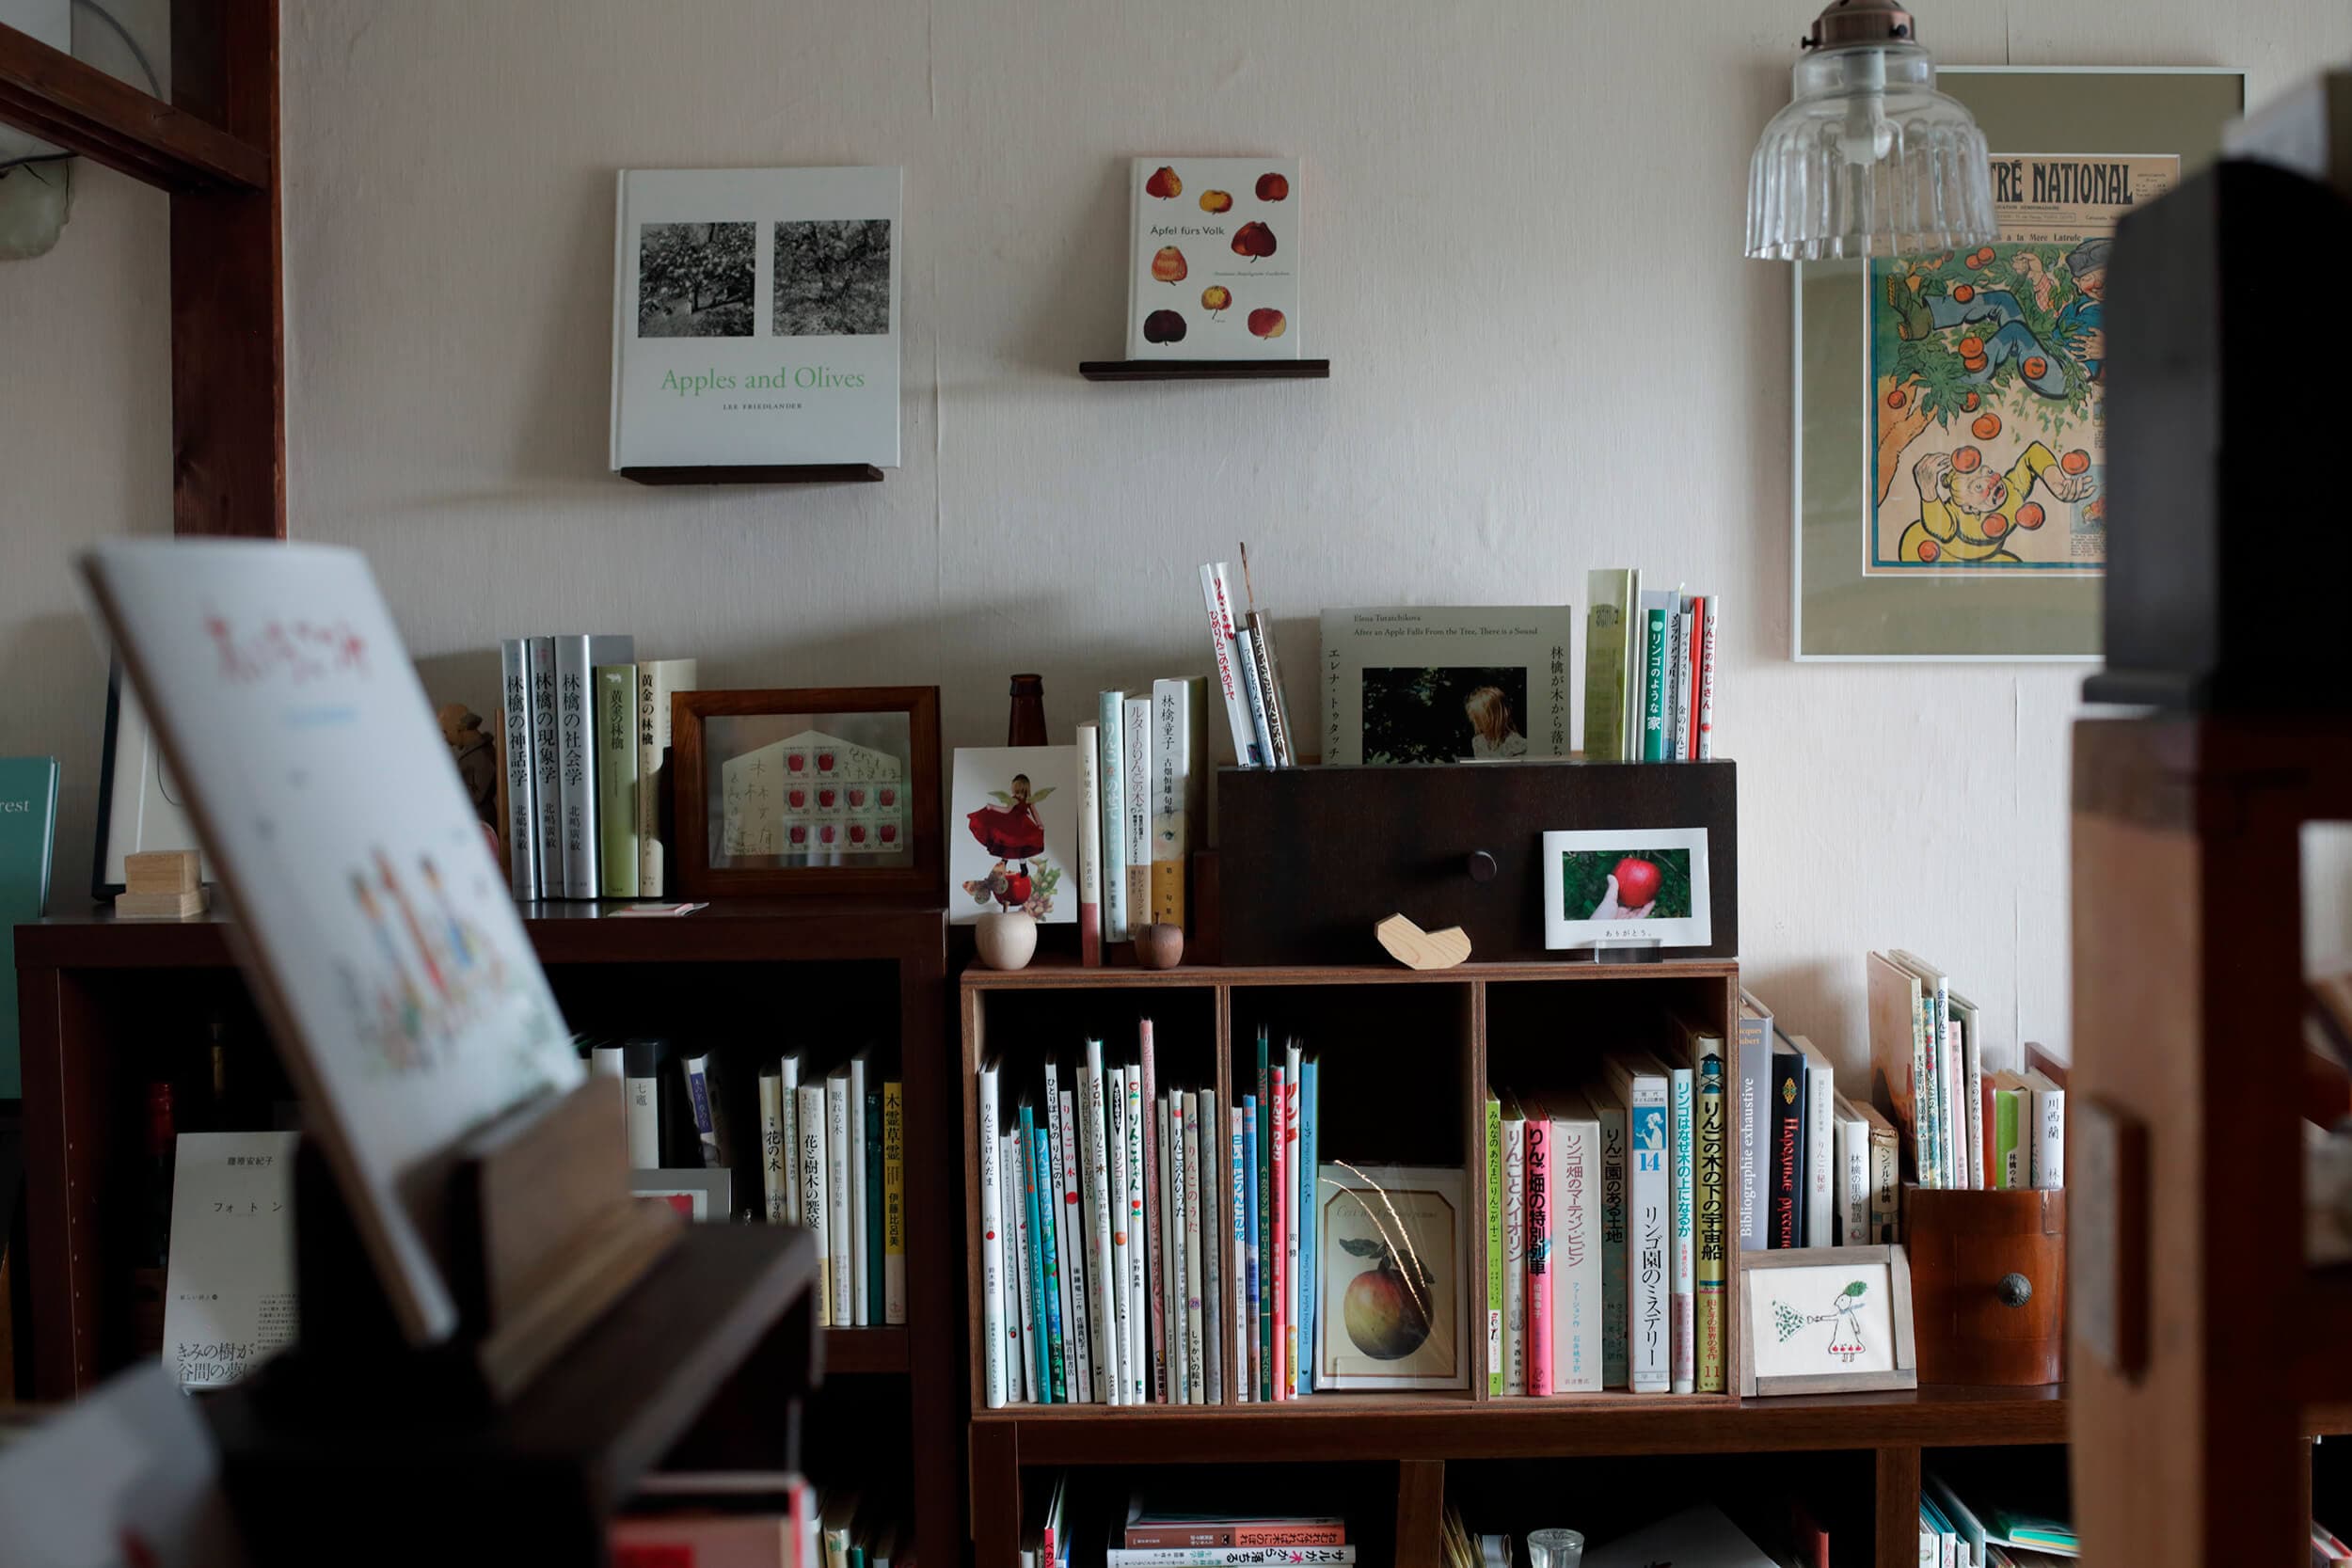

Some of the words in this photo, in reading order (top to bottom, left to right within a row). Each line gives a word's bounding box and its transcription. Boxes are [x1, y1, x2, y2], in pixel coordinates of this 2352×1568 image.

[2032, 162, 2134, 204] NATIONAL
[1151, 225, 1177, 237] Äpfel
[1181, 226, 1200, 235] fürs
[1202, 226, 1225, 235] Volk
[661, 369, 736, 396] Apples
[744, 367, 787, 390] and
[794, 366, 866, 389] Olives
[1209, 610, 1235, 700] ひめりんごの木の下で
[1354, 626, 1373, 636] After
[1384, 627, 1405, 638] Apple
[1406, 626, 1424, 636] Falls
[1424, 626, 1444, 636] From
[1446, 626, 1458, 636] the
[1514, 626, 1538, 635] Sound
[1702, 615, 1715, 710] りんごのおじさん
[642, 673, 654, 746] 黄金の林檎
[1647, 633, 1663, 731] リンゴのような家
[507, 674, 528, 788] 林檎の神話学
[535, 672, 557, 784] 林檎の現象学
[564, 673, 582, 786] 林檎の社会学
[610, 689, 625, 751] 黄金の林檎
[1161, 694, 1175, 751] 林檎童子
[1676, 705, 1687, 756] 金のりんご
[1130, 705, 1144, 807] ルターのりんごの木
[831, 1091, 843, 1134] 眠れる木
[1047, 1078, 1059, 1140] ひとりぼっちの
[1489, 1110, 1499, 1148] みんなの
[1740, 1077, 1755, 1148] exhaustive
[2047, 1098, 2060, 1140] 川西蘭
[766, 1130, 782, 1172] 花の木
[984, 1102, 994, 1187] りんごとけんだま
[1052, 1147, 1062, 1190] りんごのき
[1062, 1104, 1076, 1178] りんごの木
[1128, 1114, 1141, 1192] りんごちゃん
[1489, 1149, 1499, 1186] あたまに
[1639, 1151, 1661, 1172] 14
[1677, 1082, 1692, 1238] リンゴはなぜ木の上になるか
[1186, 1147, 1200, 1233] りんごのうた
[1489, 1186, 1499, 1223] りんごが
[1528, 1128, 1546, 1276] りんご畑の特別列車
[1565, 1133, 1586, 1268] リンゴ畑のマーティン・ピピン
[1605, 1128, 1623, 1243] りんご園のある土地
[1702, 1101, 1724, 1261] りんごの木の下の宇宙船
[1740, 1150, 1756, 1238] Bibliographie
[1851, 1152, 1863, 1224] 林檎の里の物語
[1882, 1147, 1892, 1203] ヘンデルと林檎
[889, 1192, 899, 1247] 伊藤比呂美
[1489, 1225, 1500, 1243] 十こ
[1642, 1206, 1663, 1367] リンゴ園のミステリー
[176, 1342, 255, 1362] きみの樹が
[1704, 1365, 1720, 1378] 11
[1226, 1549, 1345, 1564] サルが木から落ちる
[1239, 1530, 1339, 1545] ねむれなければ木にのぼれ
